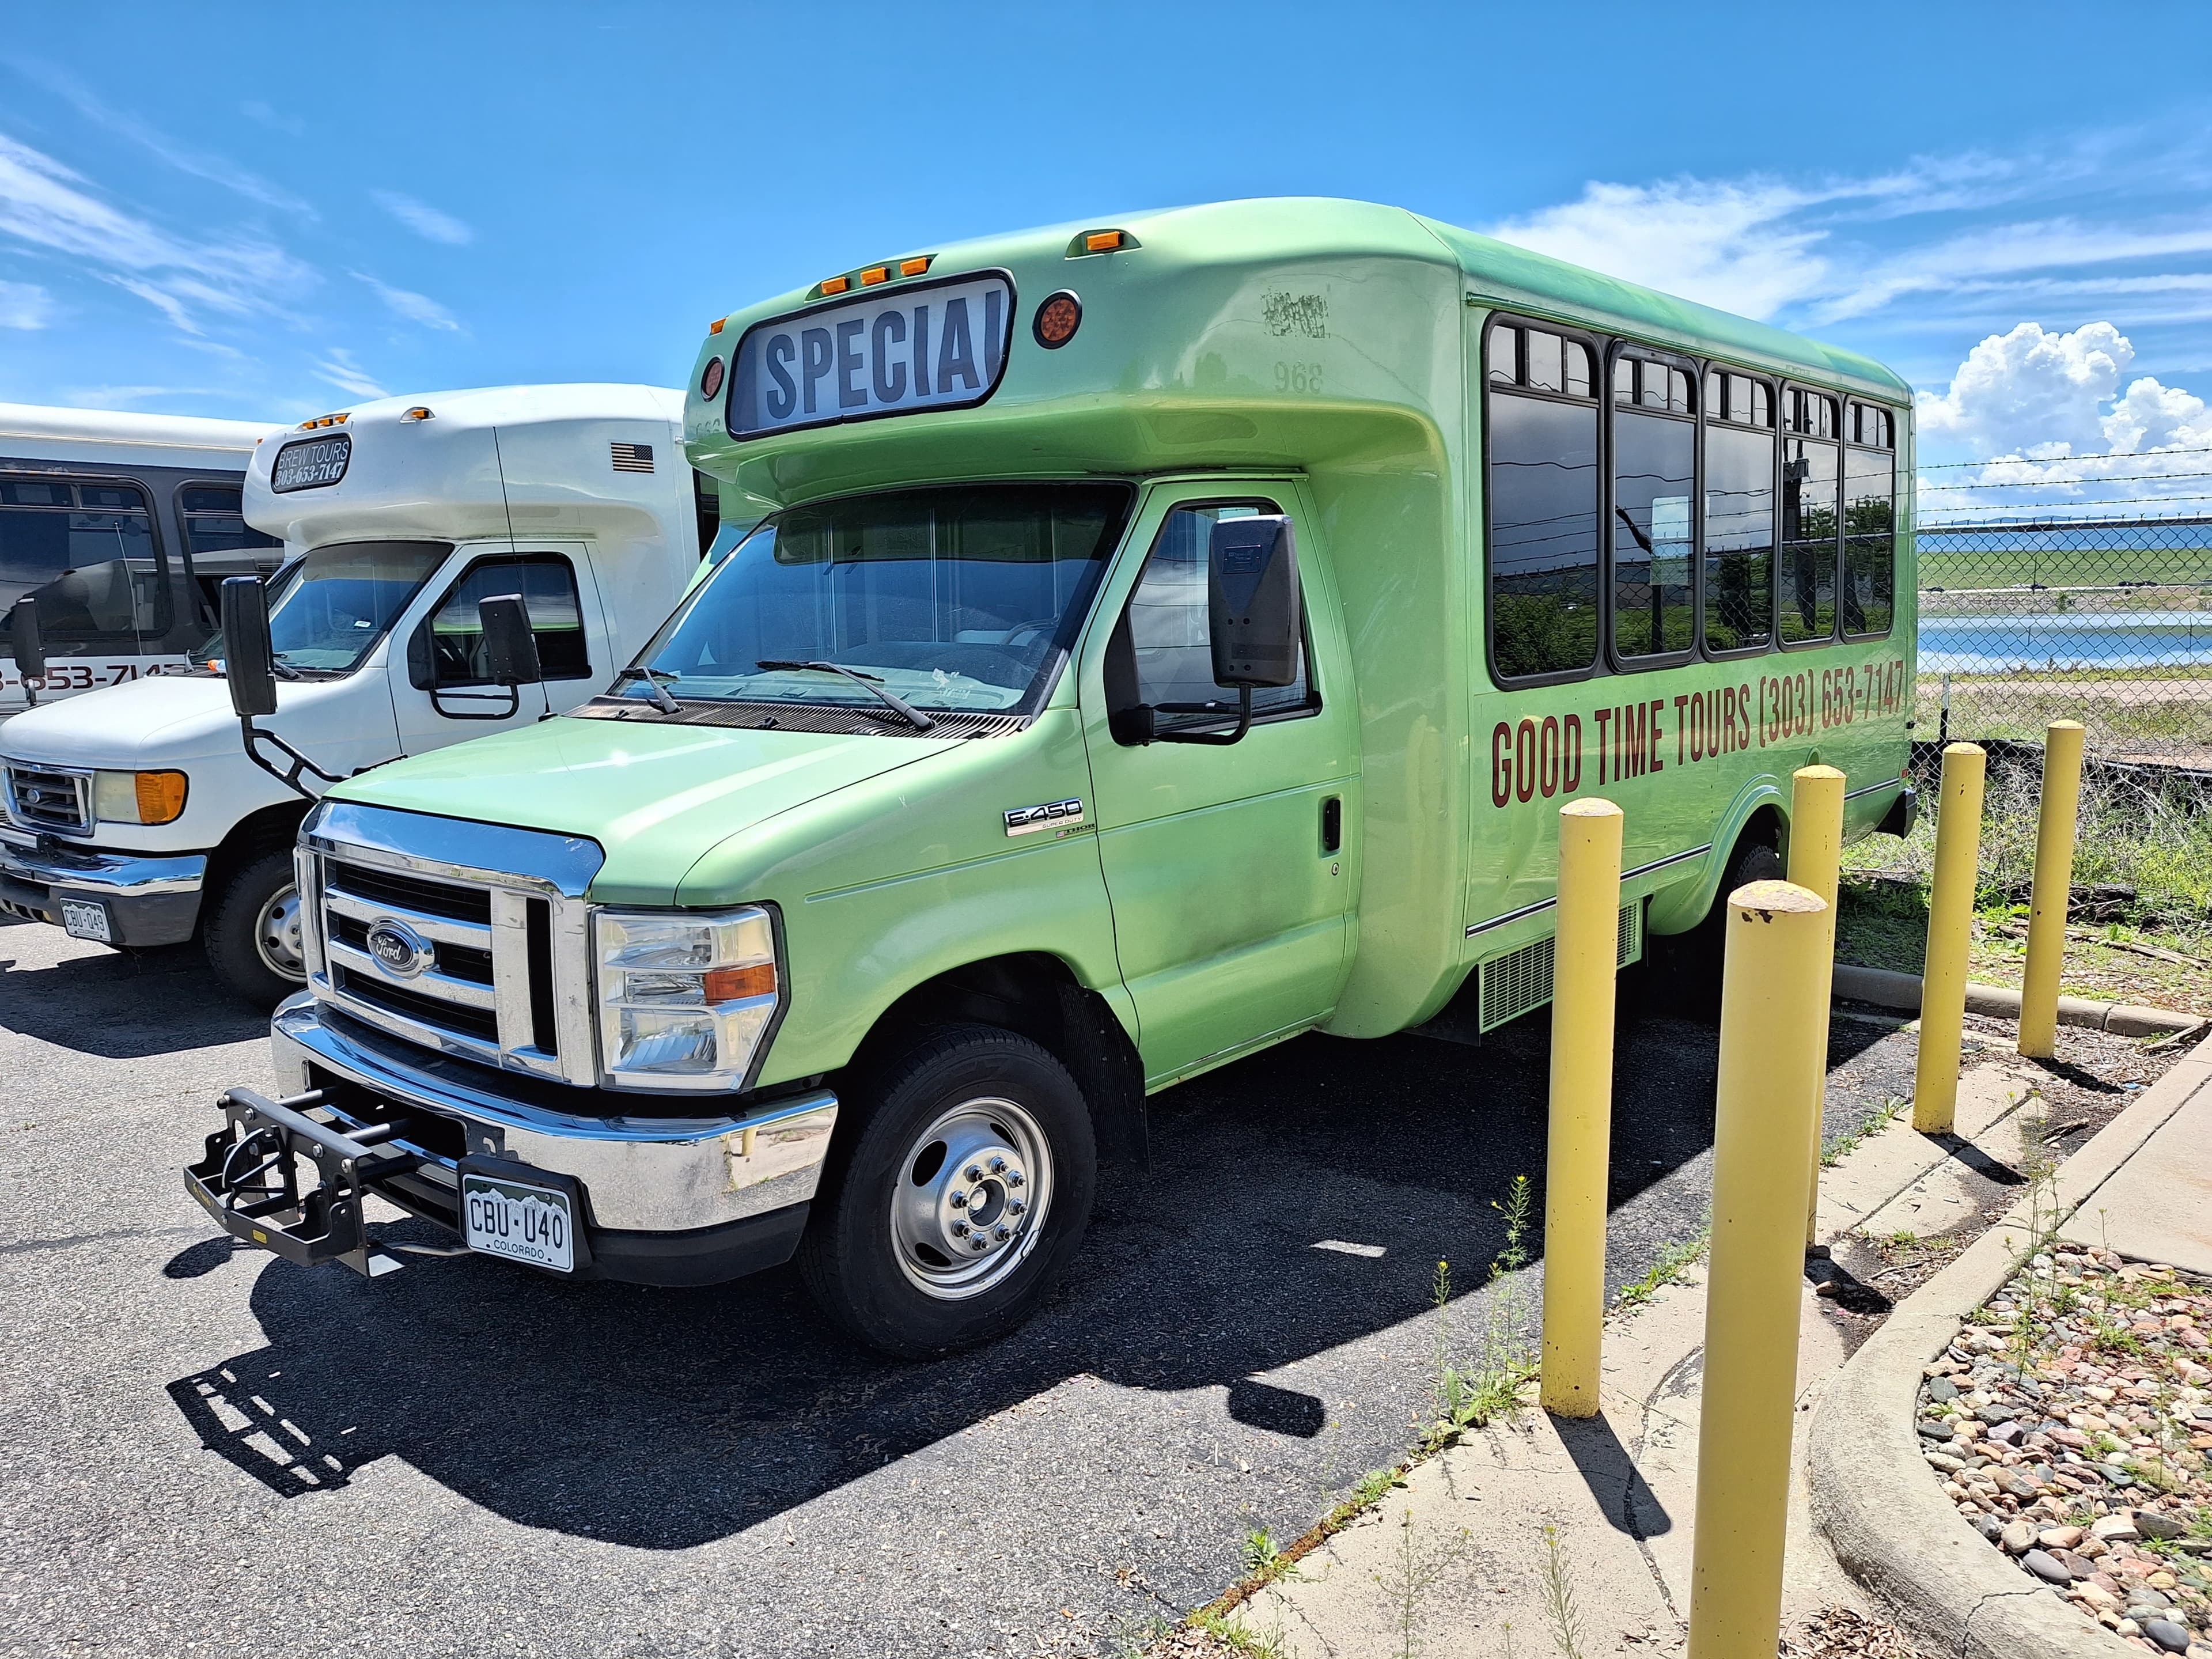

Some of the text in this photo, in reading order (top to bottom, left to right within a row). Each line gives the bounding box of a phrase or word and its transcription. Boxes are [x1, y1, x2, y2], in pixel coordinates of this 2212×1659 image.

[277, 441, 349, 469] BREW TOURS
[275, 461, 344, 487] 303-653-7147
[1492, 660, 1903, 808] GOOD TIME TOURS (303) 653-7147
[1065, 823, 1095, 834] THOR
[373, 934, 402, 961] Ford
[494, 1240, 544, 1259] COLORADO
